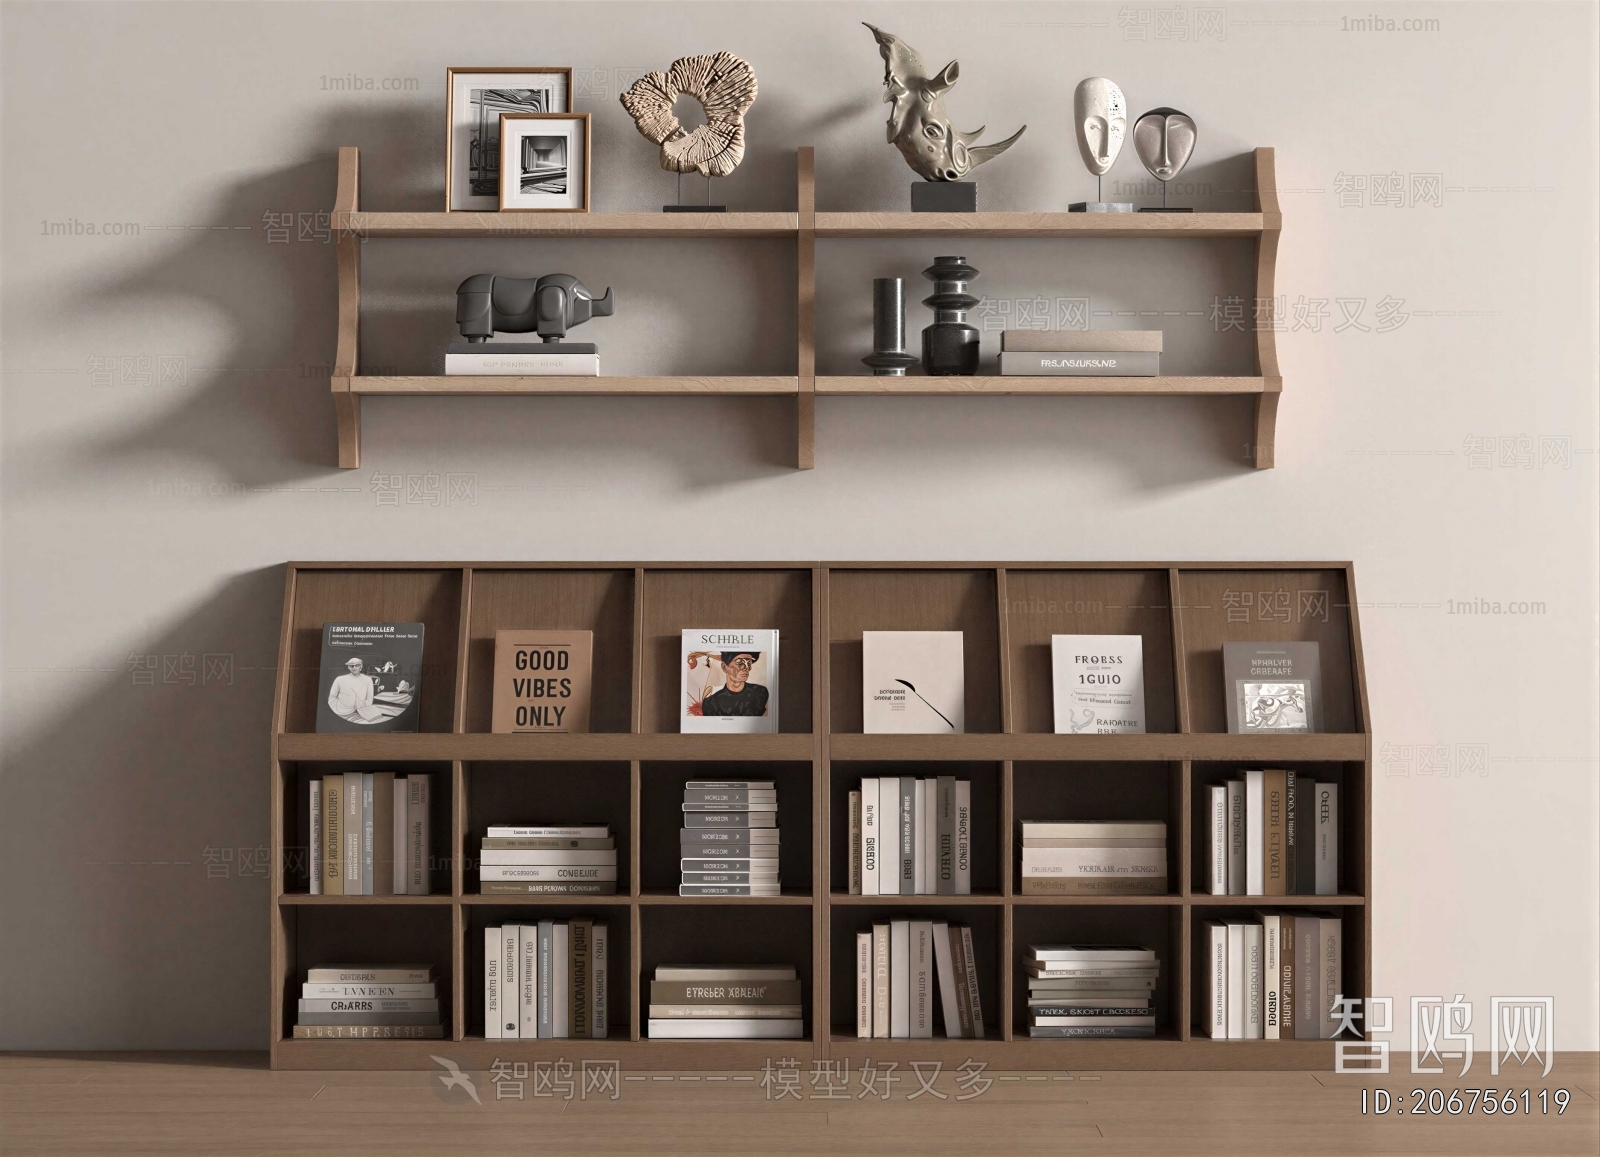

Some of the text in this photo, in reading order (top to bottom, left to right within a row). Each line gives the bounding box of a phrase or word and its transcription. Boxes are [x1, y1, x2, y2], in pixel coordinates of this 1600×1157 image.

[515, 650, 569, 671] GOOD
[513, 678, 572, 698] VIBES
[515, 706, 567, 727] ONLY
